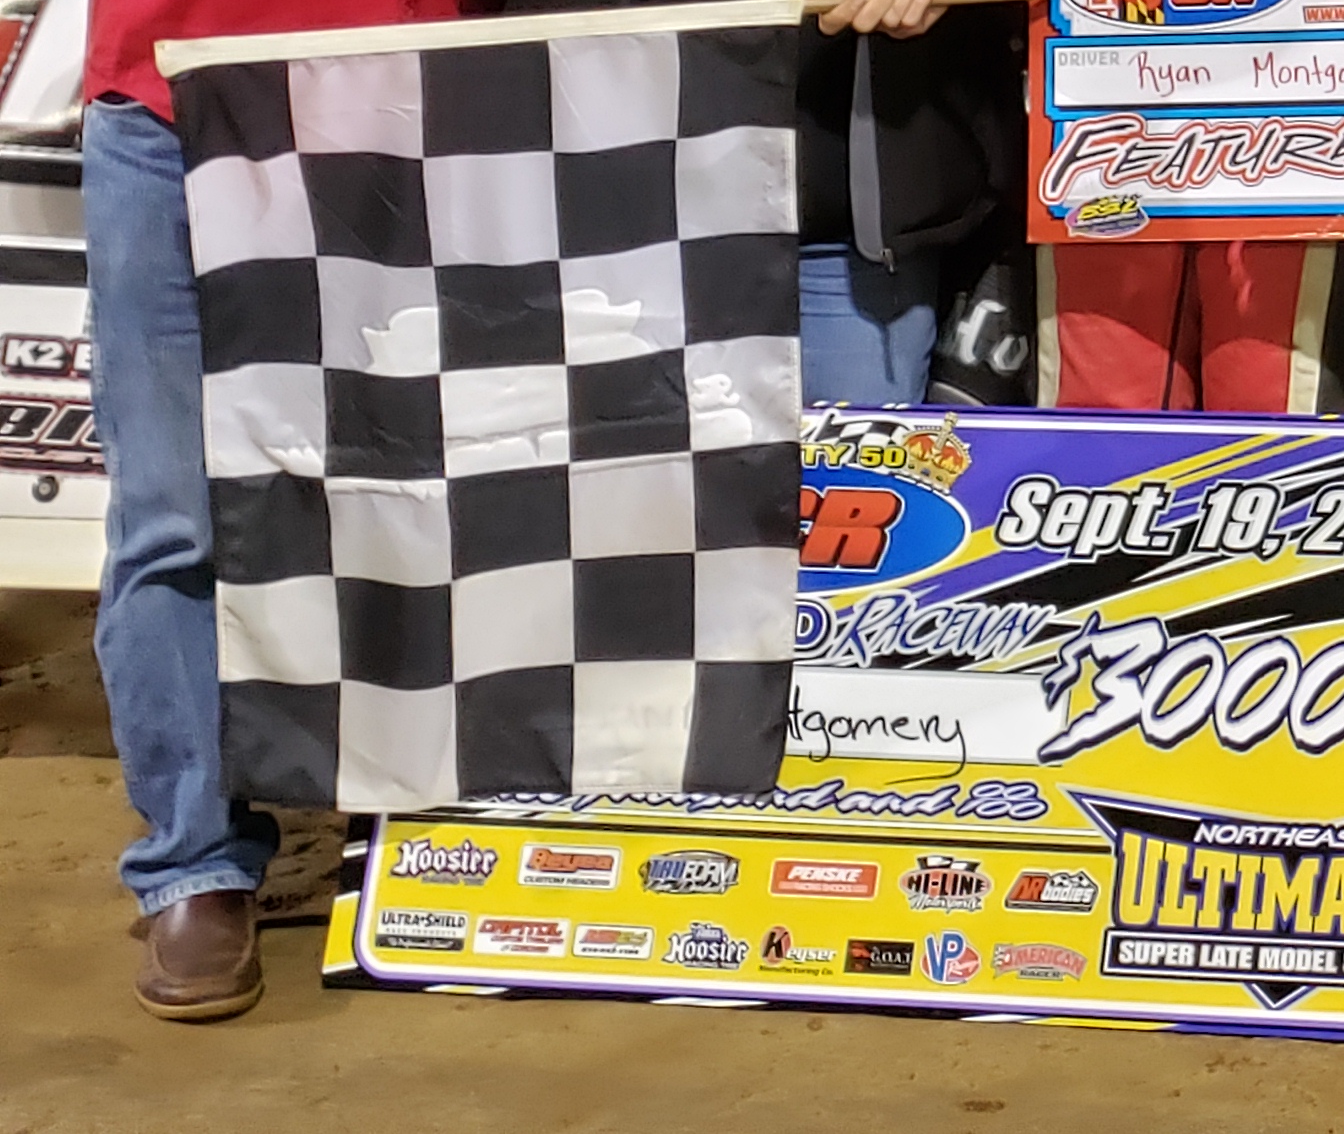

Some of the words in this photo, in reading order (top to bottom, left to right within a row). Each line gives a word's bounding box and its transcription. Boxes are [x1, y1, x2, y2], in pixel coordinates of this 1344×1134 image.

[1057, 51, 1120, 66] DRIVER
[1128, 51, 1212, 97] Ryan
[4, 338, 64, 369] K2
[994, 474, 1172, 560] Sept.
[1200, 482, 1284, 560] 19,
[828, 590, 1058, 666] RACEWAY
[787, 685, 967, 785] tgomery
[787, 865, 864, 883] PENSKE
[905, 872, 987, 897] HI-LINE
[761, 929, 837, 964] Keyser
[925, 931, 965, 983] VP
[1118, 939, 1194, 968] SUPER
[1199, 942, 1254, 971] LATE
[1258, 946, 1338, 974] MODEL
